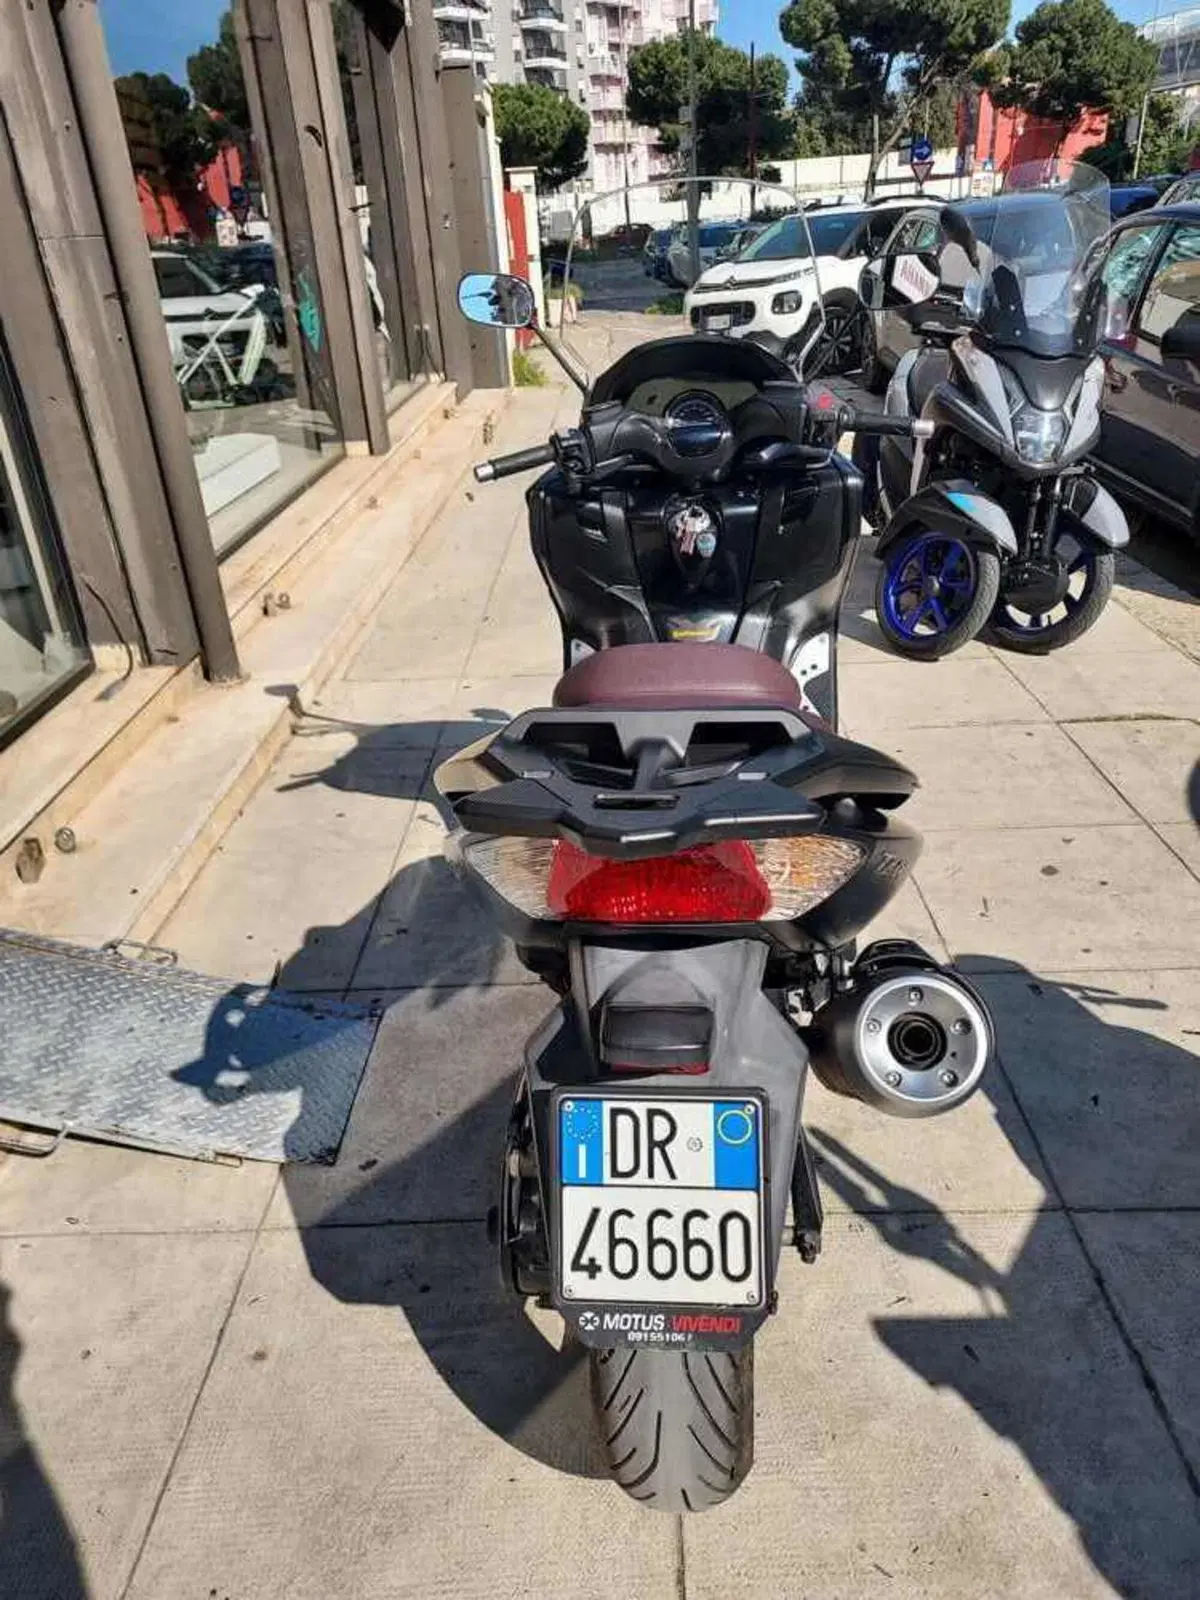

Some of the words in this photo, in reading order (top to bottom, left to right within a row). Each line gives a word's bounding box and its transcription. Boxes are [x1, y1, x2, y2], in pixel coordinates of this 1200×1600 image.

[609, 1107, 678, 1180] DR
[570, 1207, 751, 1283] 46660
[602, 1313, 665, 1331] MOTUS
[671, 1314, 742, 1333] VIVENDI
